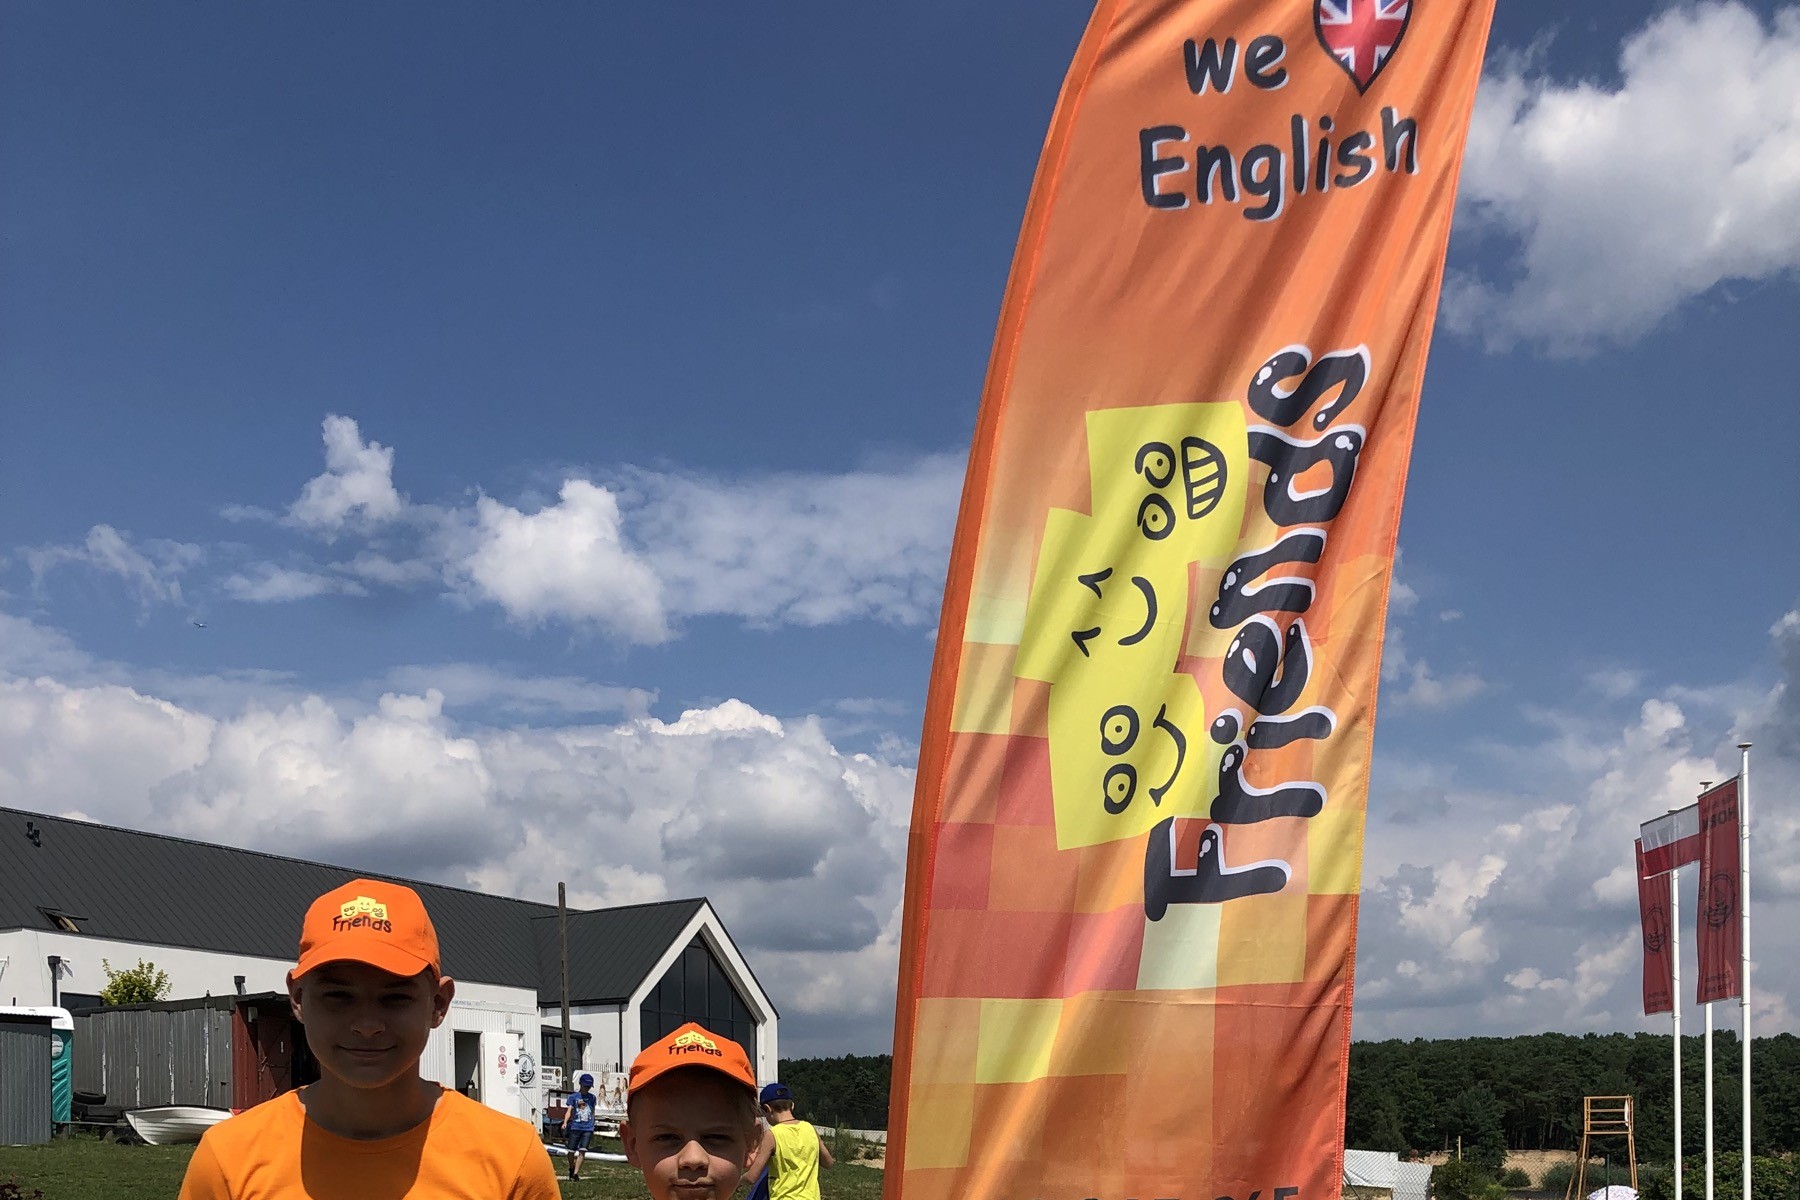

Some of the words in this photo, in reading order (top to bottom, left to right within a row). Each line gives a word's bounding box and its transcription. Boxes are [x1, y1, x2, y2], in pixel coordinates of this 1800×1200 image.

[1183, 35, 1289, 96] we
[1139, 106, 1418, 222] English
[1144, 343, 1371, 922] Friends
[332, 914, 392, 933] Friends
[668, 1044, 722, 1057] Friends
